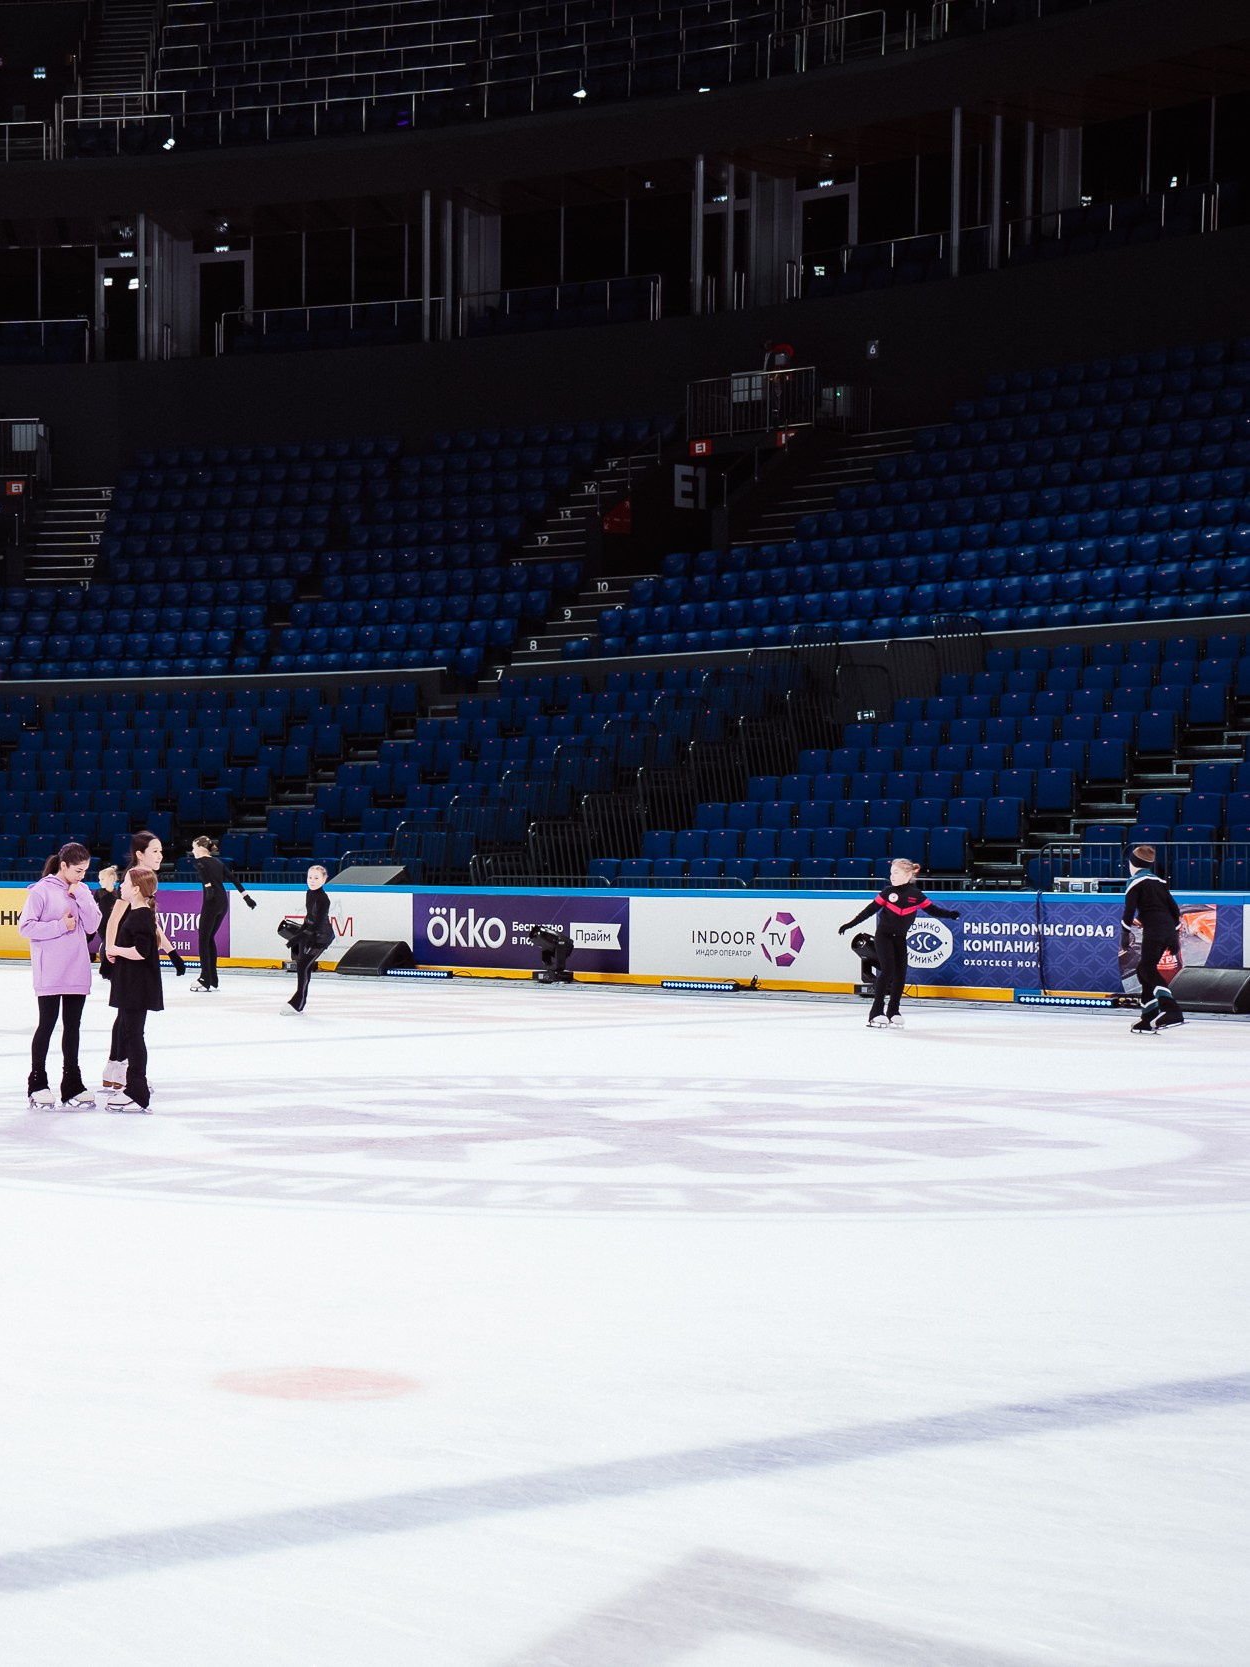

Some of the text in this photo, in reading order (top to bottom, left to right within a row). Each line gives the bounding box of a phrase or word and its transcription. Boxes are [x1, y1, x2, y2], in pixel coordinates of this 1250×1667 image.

[869, 344, 877, 355] 6
[695, 443, 706, 453] E1
[11, 483, 23, 493] E1
[674, 464, 707, 510] E1
[102, 490, 112, 499] 15
[95, 512, 107, 521] 14
[560, 511, 571, 520] 13
[90, 534, 101, 544] 13
[537, 536, 549, 546] 12
[83, 558, 95, 567] 12
[597, 582, 608, 592] 10
[564, 609, 572, 620] 9
[529, 640, 537, 651] 8
[496, 669, 504, 680] 7
[963, 922, 1114, 937] РЫБОПРОМЫСЛОВАЯ
[575, 930, 611, 943] Прайм
[692, 930, 787, 945] INDOOR TV
[695, 949, 752, 957] ИНДОР ОПЕРАТОР
[963, 959, 1041, 968] ОХОТСКОЕ МОР
